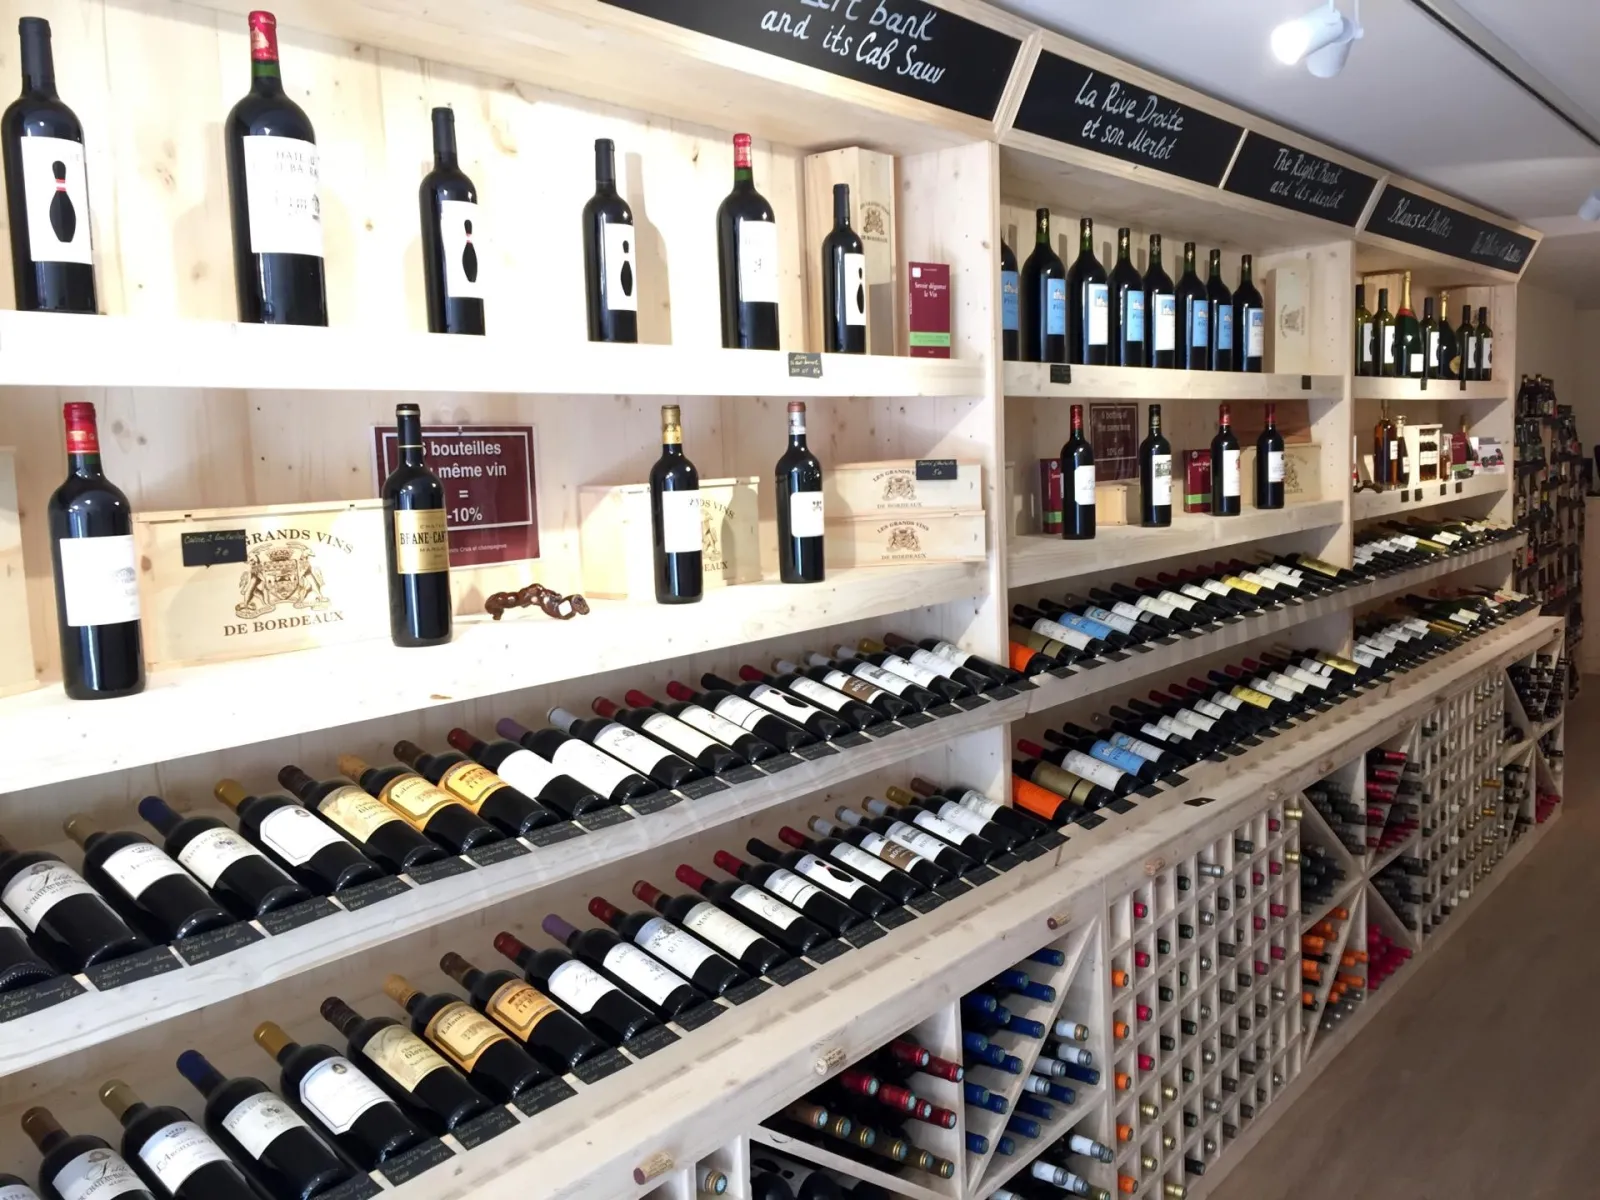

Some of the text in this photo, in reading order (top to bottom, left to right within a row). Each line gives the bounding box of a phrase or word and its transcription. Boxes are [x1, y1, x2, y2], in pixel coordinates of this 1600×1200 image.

[868, 2, 935, 41] bank
[761, 8, 810, 40] and
[822, 24, 854, 57] its
[855, 32, 898, 71] Cab
[1074, 72, 1184, 132] La Rive Droite
[1082, 116, 1178, 160] et son Merlot
[1273, 148, 1293, 171] The
[1270, 180, 1294, 197] and
[431, 440, 502, 456] bouteilles
[438, 462, 507, 479] même vin
[885, 468, 911, 476] GRANDS
[887, 501, 923, 509] BORDEAUX
[889, 519, 915, 528] GRANDS
[915, 521, 930, 532] VINS
[316, 531, 354, 555] VINS
[704, 561, 729, 572] EAUX
[223, 610, 345, 637] DE BORDEAUX
